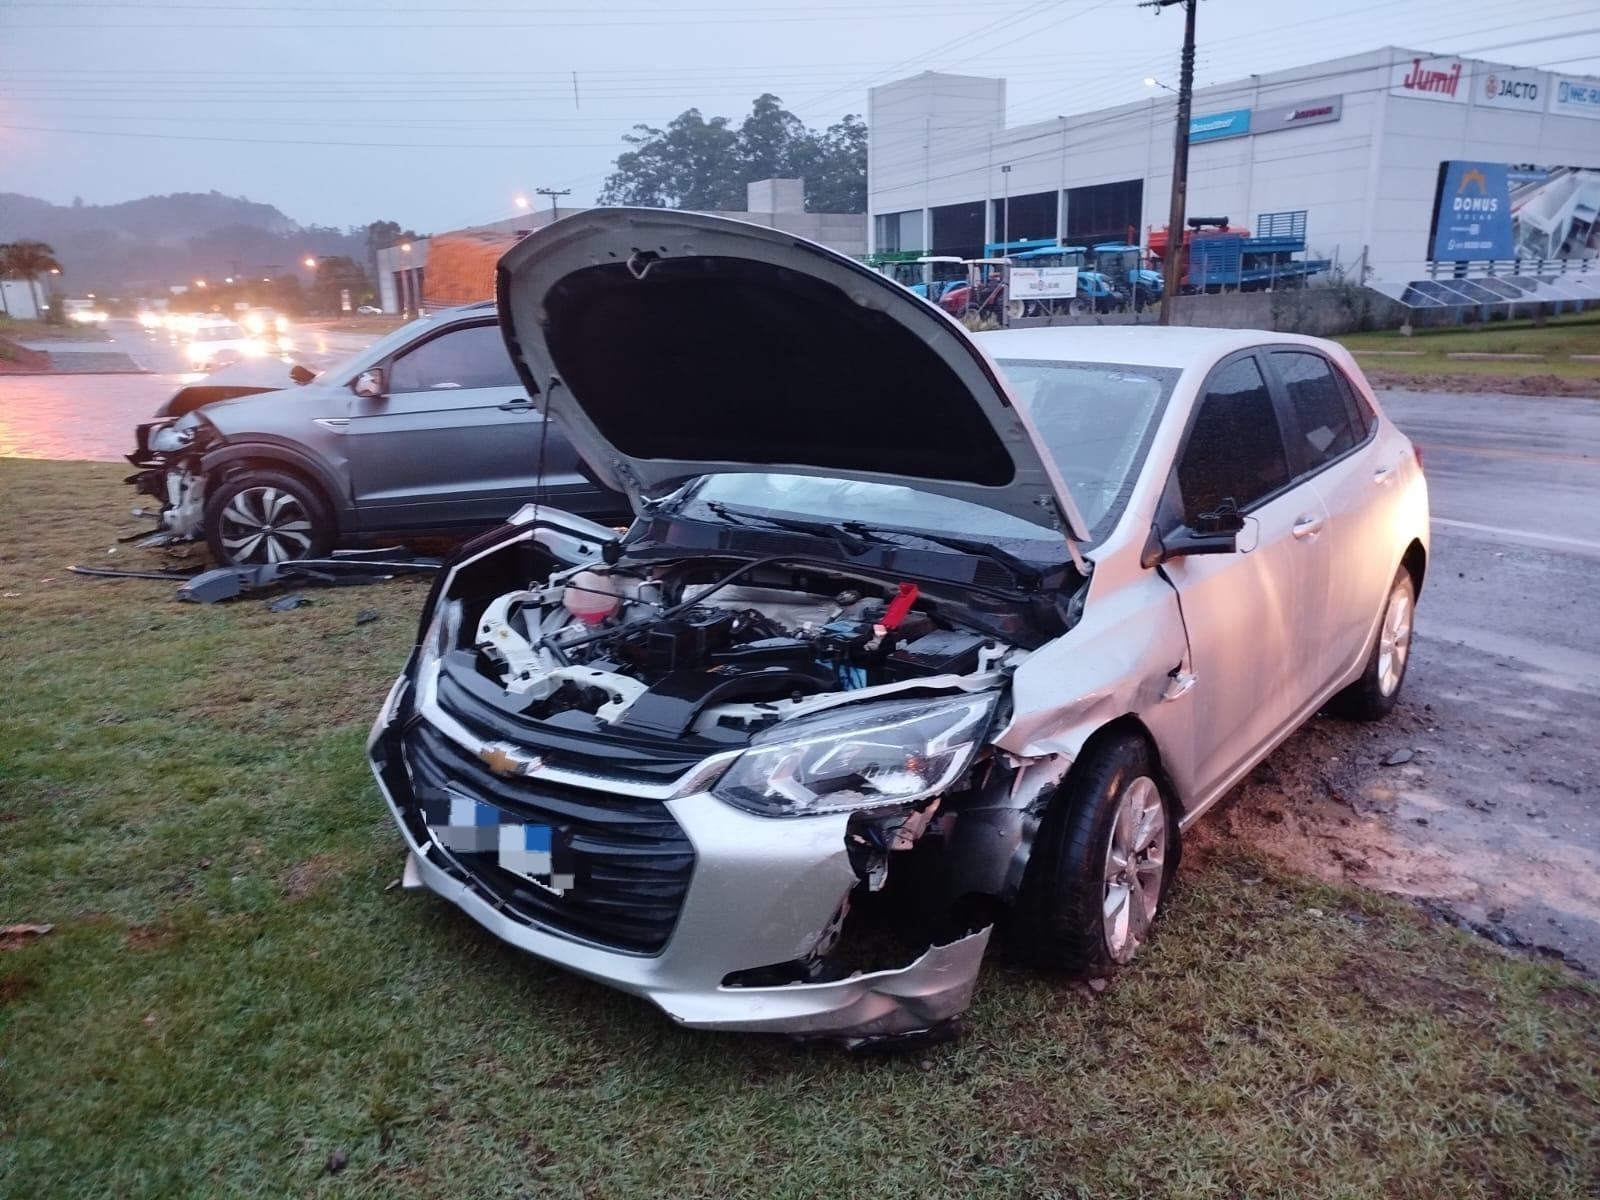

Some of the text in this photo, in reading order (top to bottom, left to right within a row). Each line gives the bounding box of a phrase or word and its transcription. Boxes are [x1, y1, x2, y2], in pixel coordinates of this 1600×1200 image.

[1404, 58, 1462, 99] Jumil
[1498, 79, 1538, 101] JACTO
[1453, 197, 1498, 212] DOMUS
